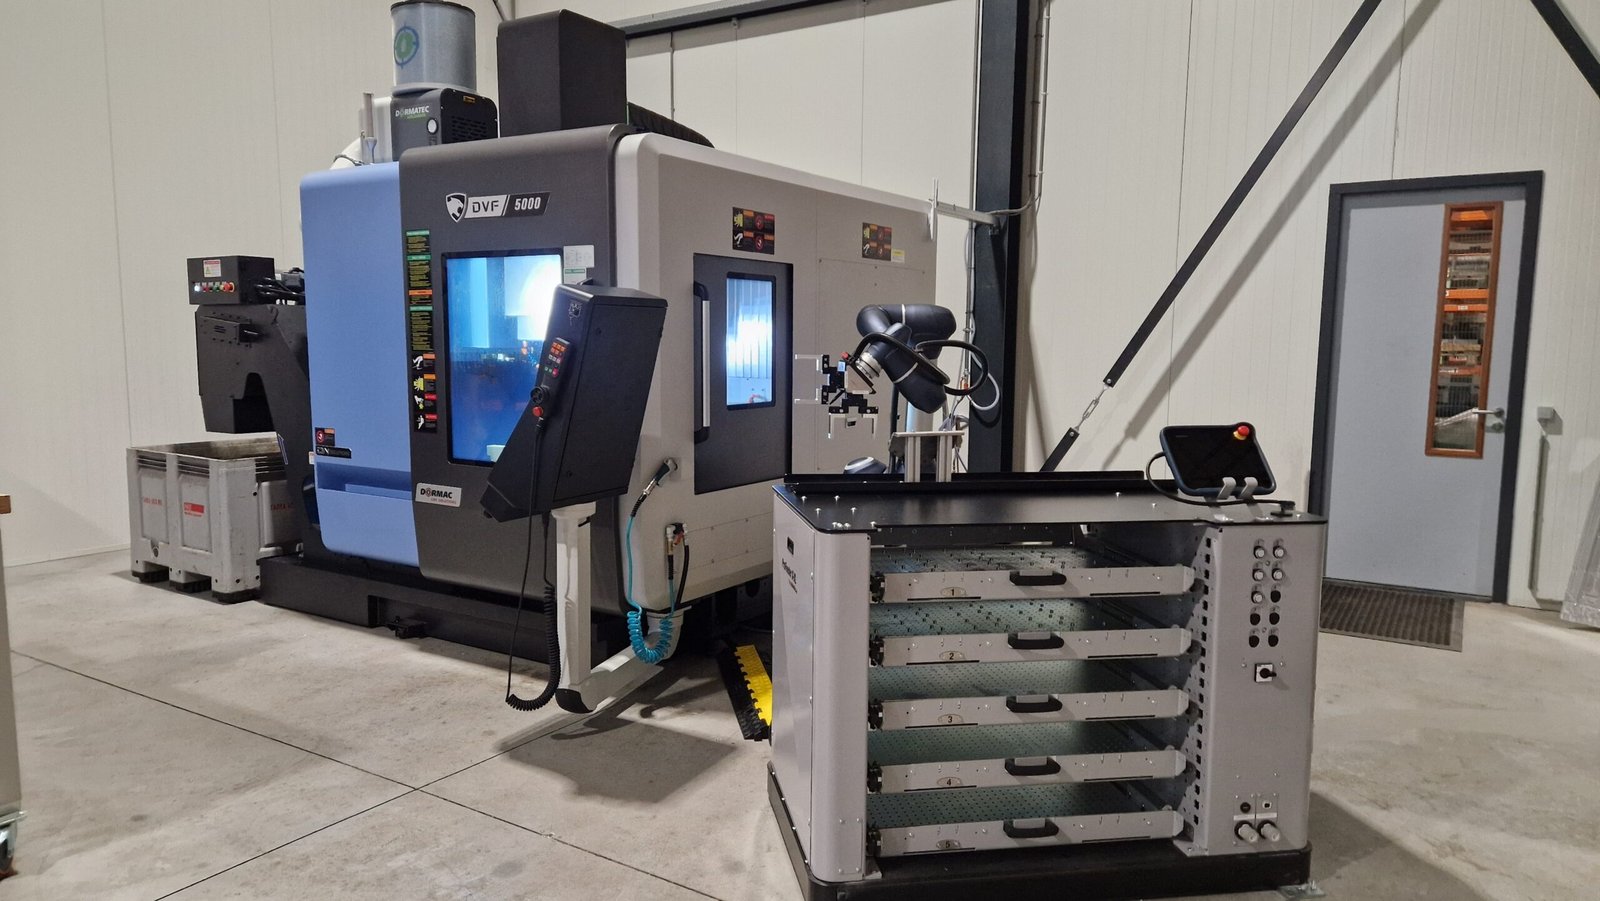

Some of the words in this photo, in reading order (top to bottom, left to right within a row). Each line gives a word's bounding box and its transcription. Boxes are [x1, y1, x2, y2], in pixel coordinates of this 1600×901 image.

[472, 200, 500, 213] DVF
[514, 197, 542, 211] 5000
[420, 487, 453, 499] DORMAC
[949, 652, 954, 660] 2
[947, 715, 953, 723] 3
[946, 778, 952, 786] 4
